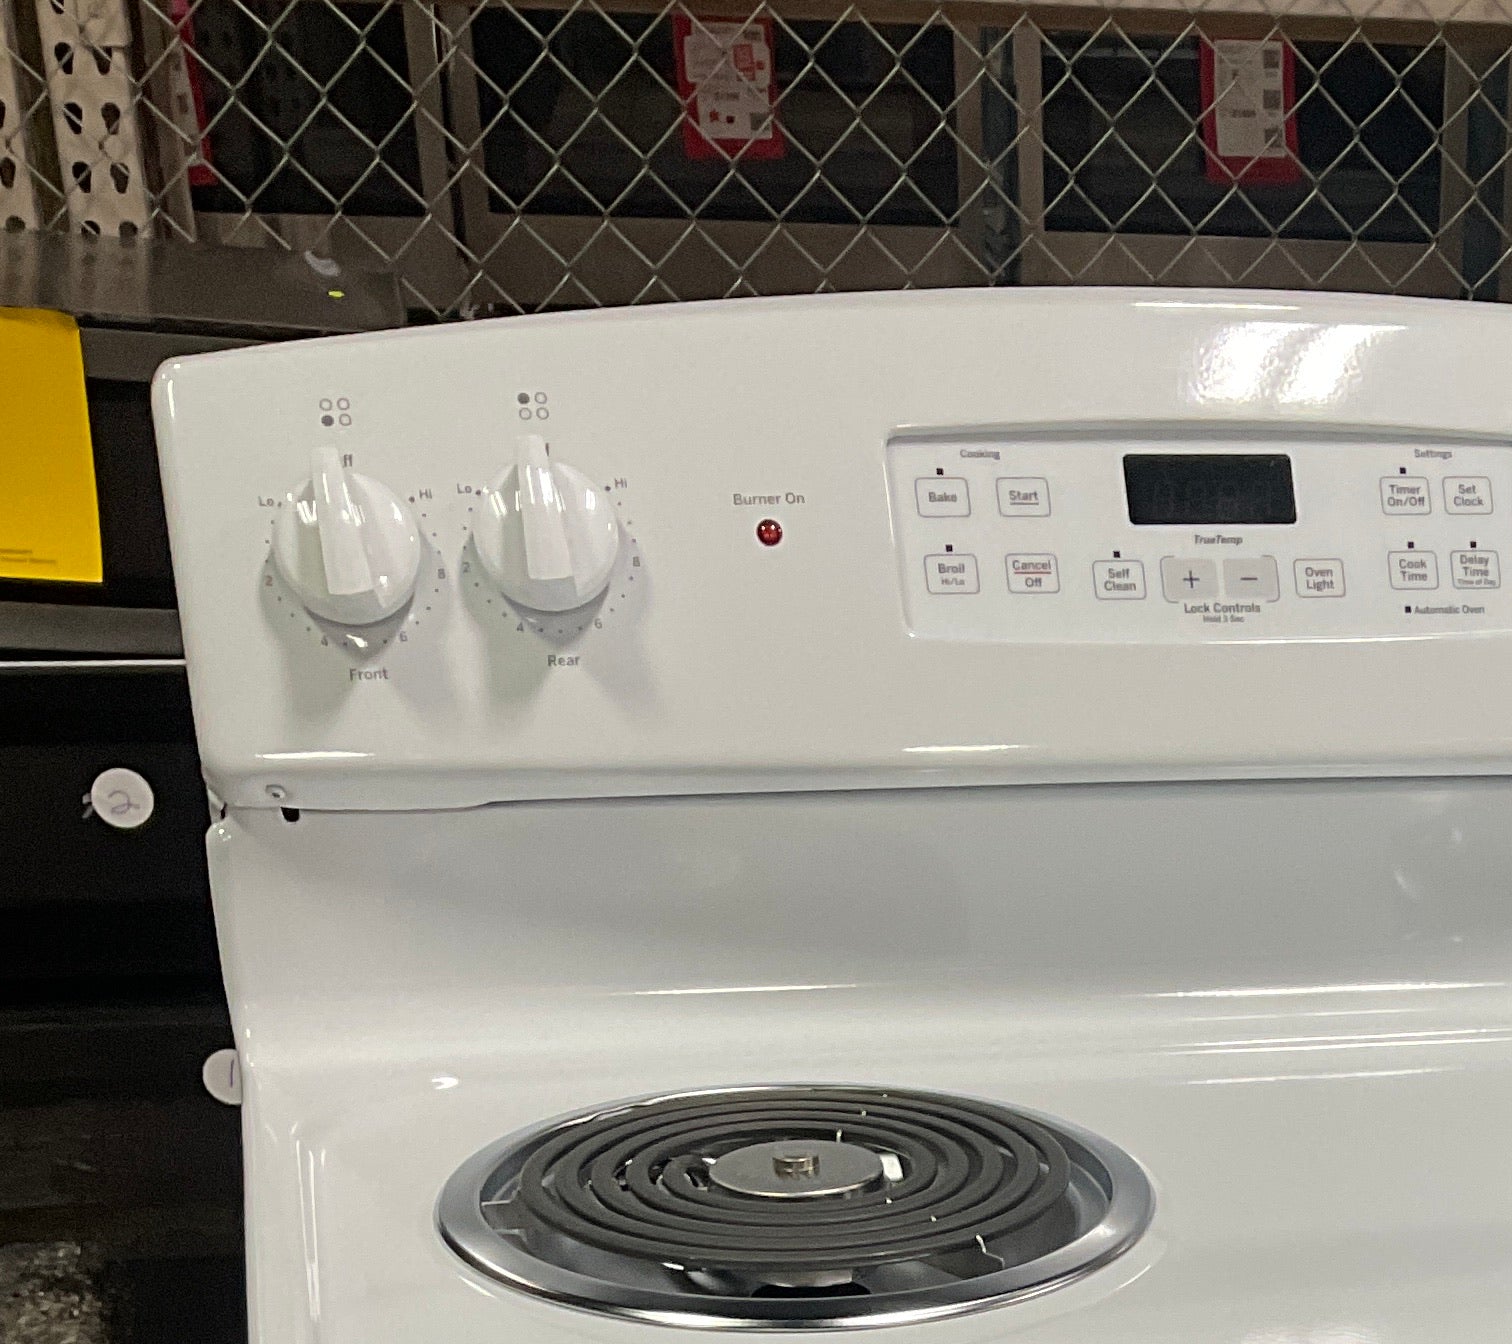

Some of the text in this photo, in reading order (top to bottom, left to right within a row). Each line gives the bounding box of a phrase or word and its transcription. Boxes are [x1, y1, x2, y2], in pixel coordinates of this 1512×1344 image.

[959, 449, 1001, 460] Cooking
[1414, 449, 1453, 460] Settings
[456, 483, 473, 494] Lo
[614, 477, 628, 489] Hi
[418, 488, 433, 500] Hi
[1389, 484, 1421, 495] Timer
[1458, 484, 1477, 494] Set
[733, 492, 806, 506] Burner On
[928, 491, 958, 503] Bake
[1008, 489, 1039, 501] Start
[258, 496, 274, 507] Lo
[1387, 496, 1425, 507] On/Off
[1453, 496, 1484, 507] Clock
[1194, 534, 1244, 546] TrueTemp
[1012, 559, 1052, 571] Cancel
[1399, 559, 1427, 569] Cook
[1459, 555, 1490, 566] Delay
[938, 563, 966, 574] Broil
[1108, 568, 1130, 579] Self
[1304, 566, 1334, 577] Oven
[1463, 566, 1490, 577] Time
[1400, 571, 1428, 581] Time
[1024, 577, 1042, 587] Off
[1104, 580, 1137, 591] Clean
[1306, 580, 1335, 592] Light
[1184, 602, 1261, 613] Lock Controls
[1414, 605, 1485, 615] Automatic Oven
[547, 654, 581, 667] Rear
[349, 668, 389, 681] Front
[107, 790, 141, 815] 2
